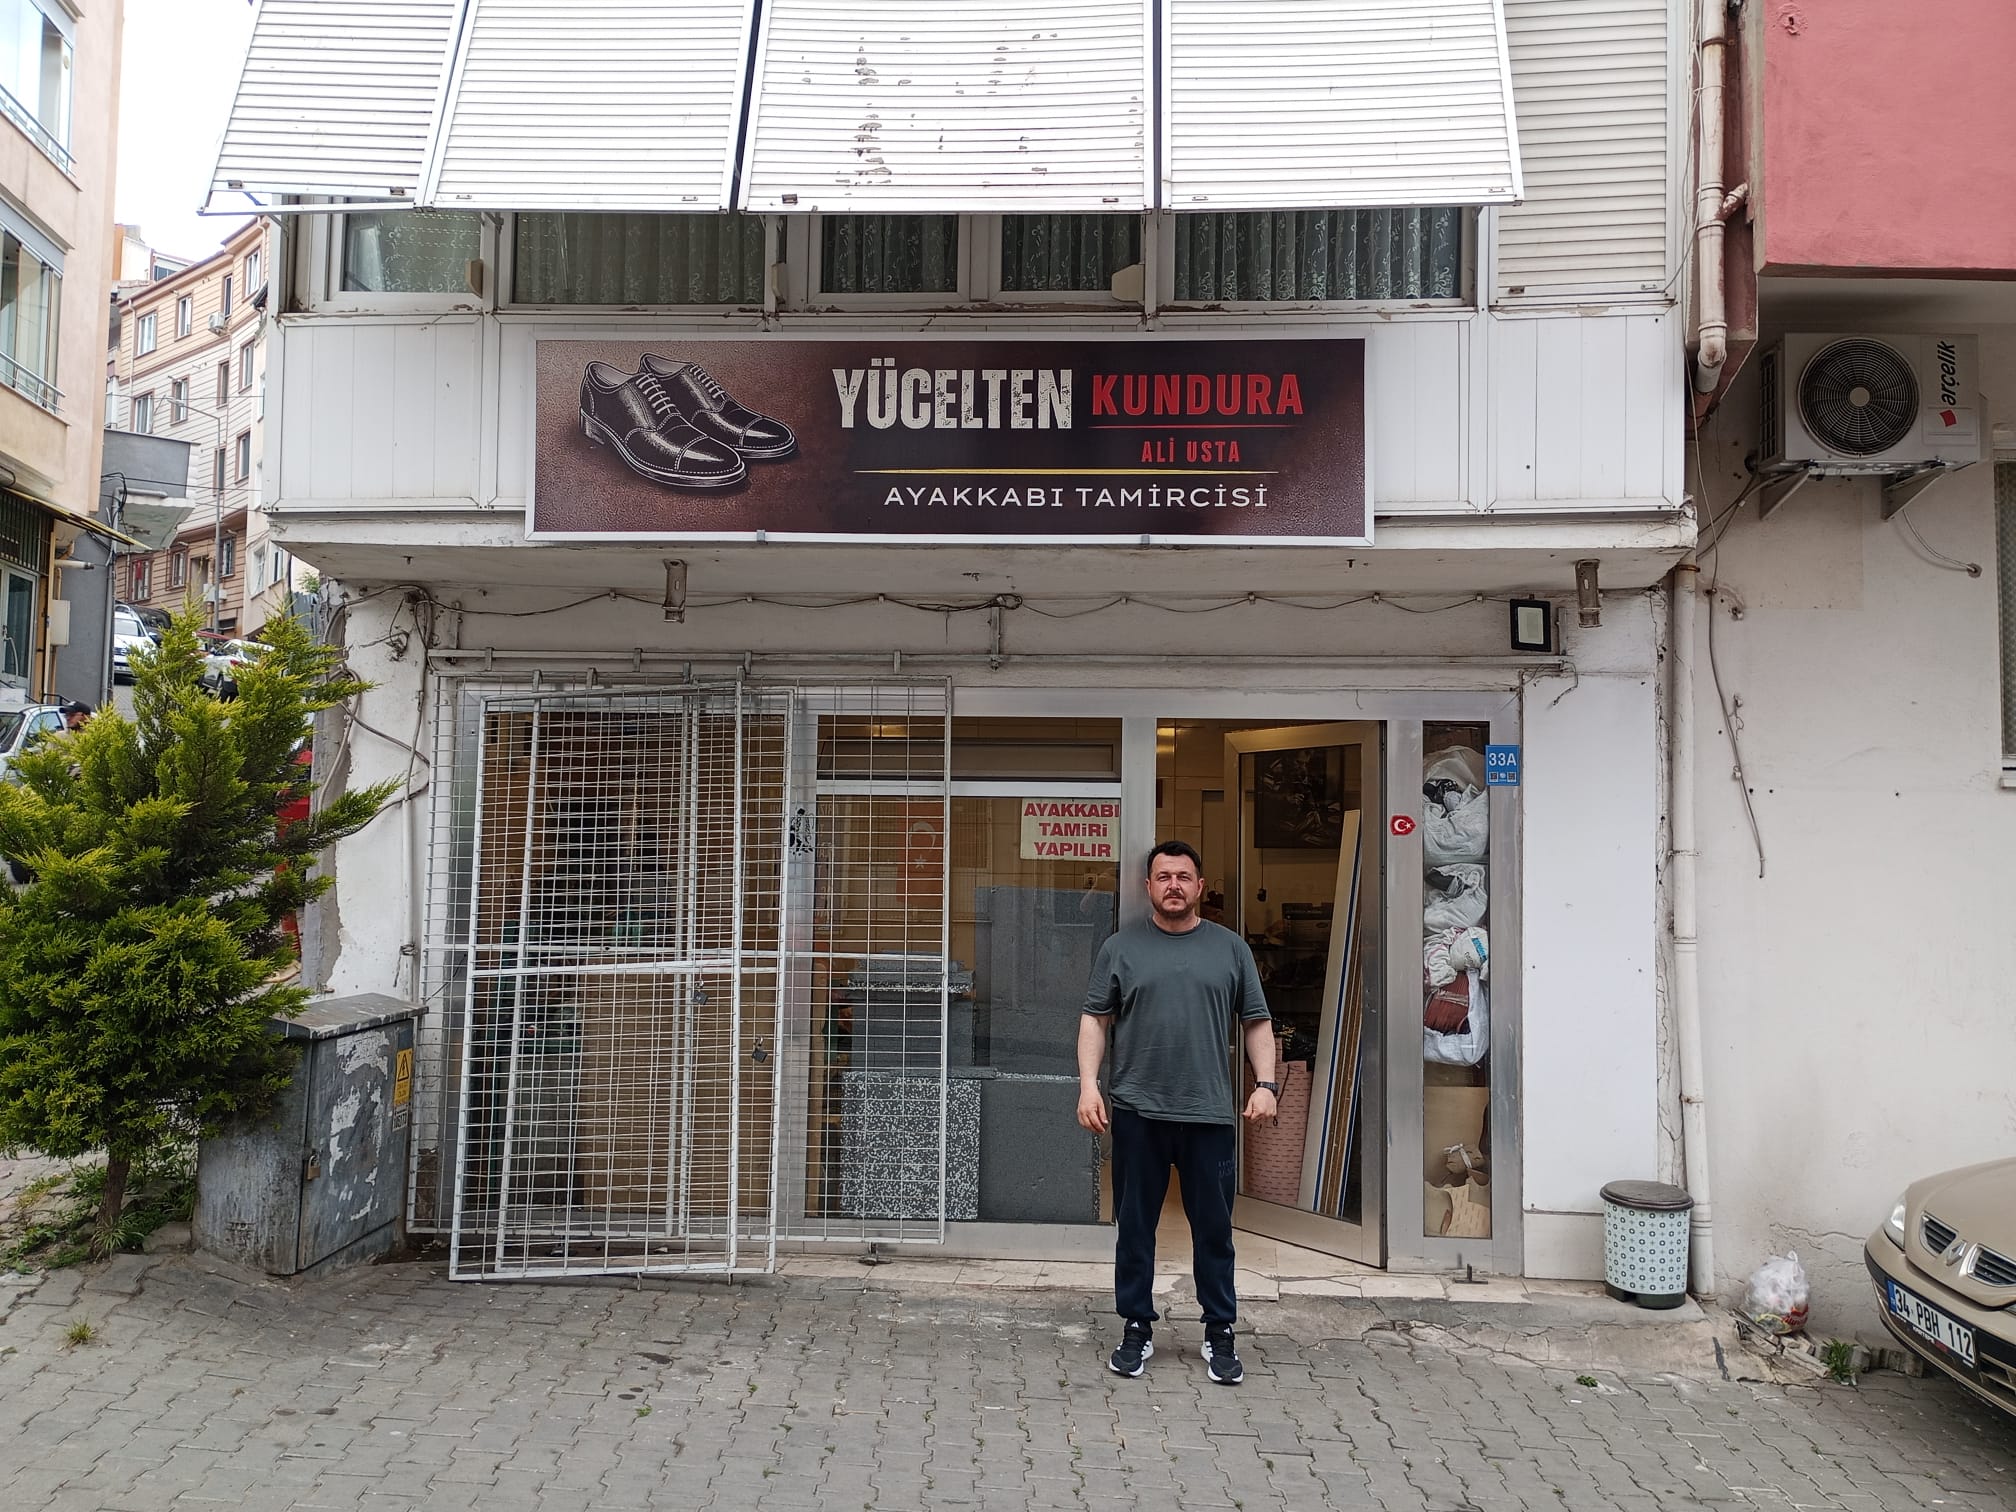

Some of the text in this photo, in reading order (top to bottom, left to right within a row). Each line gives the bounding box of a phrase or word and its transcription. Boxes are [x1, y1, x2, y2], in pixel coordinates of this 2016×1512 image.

[1937, 340, 1960, 406] arçelik
[832, 358, 1303, 429] YÜCELTEN KUNDURA
[1141, 437, 1240, 463] ALİ USTA
[884, 483, 1268, 507] AYAKKABI TAMİRCİSİ
[1489, 753, 1517, 766] 33A
[1024, 803, 1120, 817] AYAKKABI
[1034, 842, 1112, 858] YAPILIR
[1895, 1289, 1910, 1318] 34
[1916, 1302, 1940, 1338] PBH
[1948, 1322, 1974, 1360] 112
